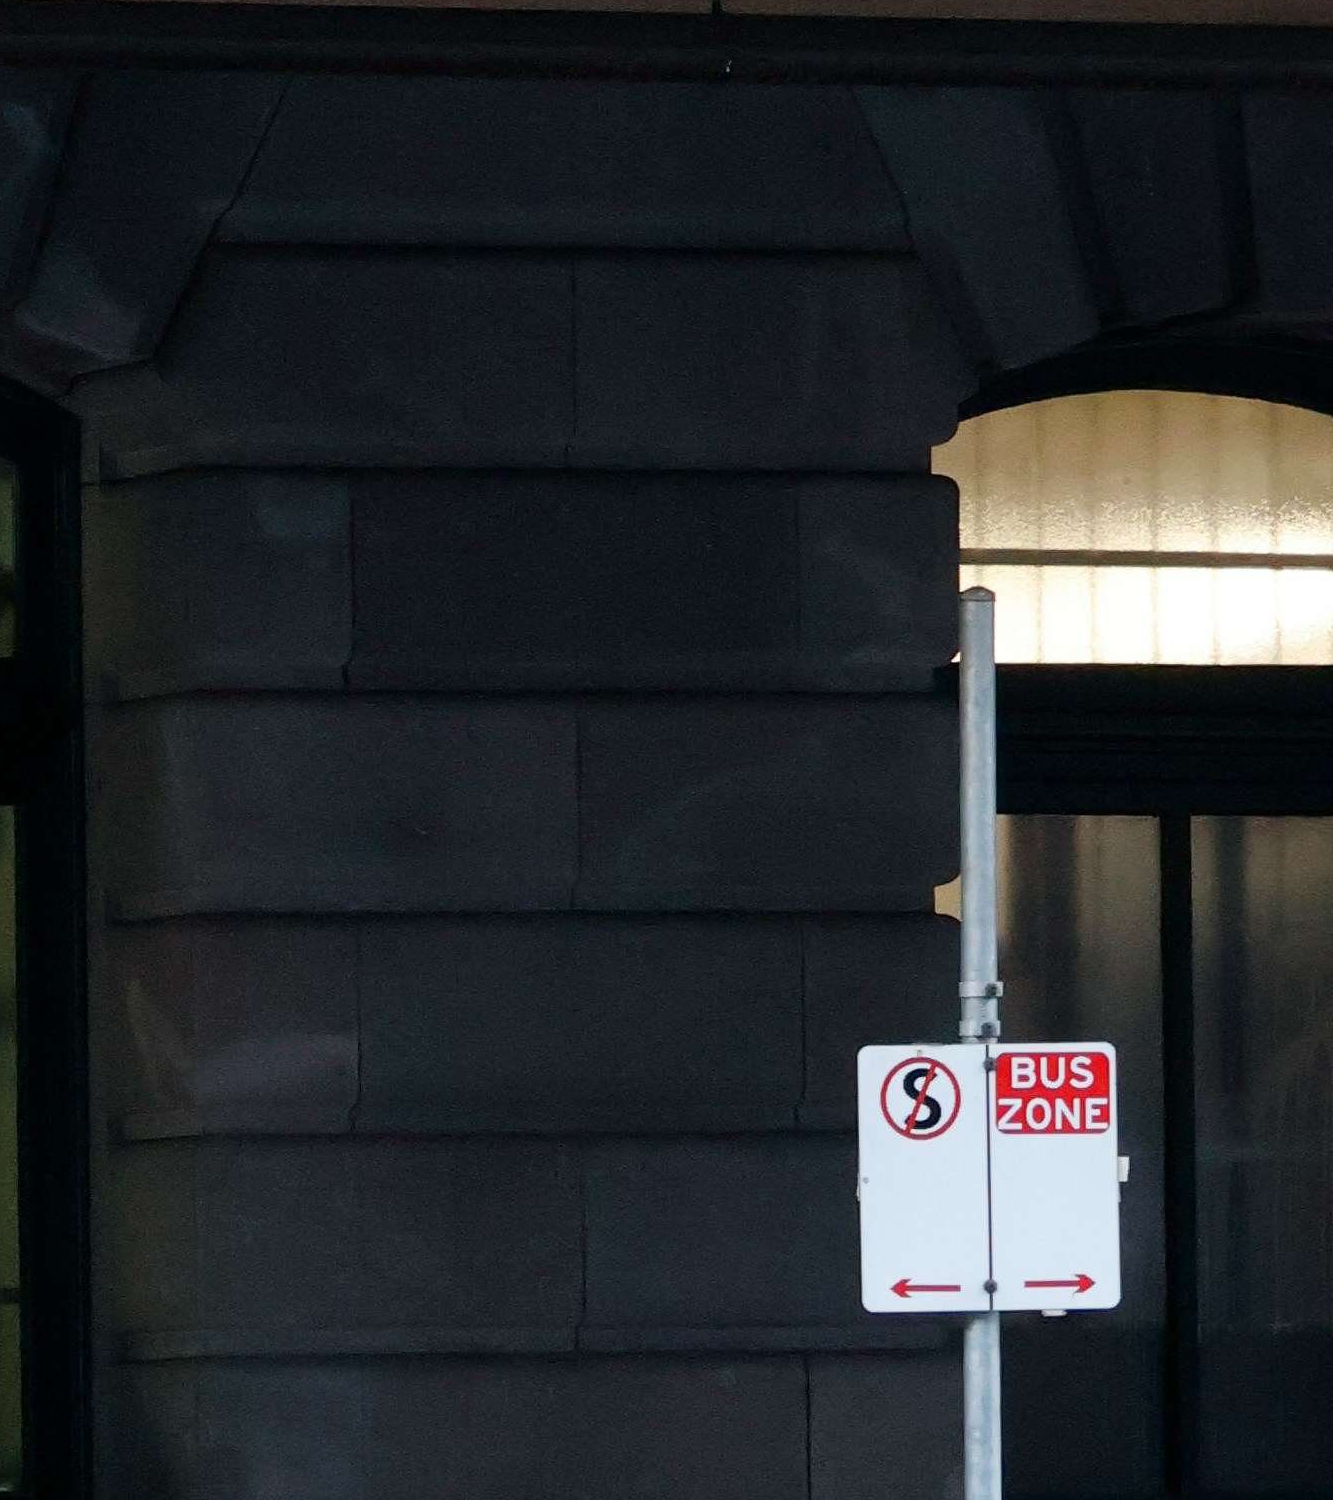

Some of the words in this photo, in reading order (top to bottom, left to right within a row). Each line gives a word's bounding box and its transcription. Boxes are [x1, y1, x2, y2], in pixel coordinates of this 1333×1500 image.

[1011, 1056, 1094, 1089] BUS
[902, 1067, 942, 1130] S
[997, 1097, 1109, 1130] ZONE
